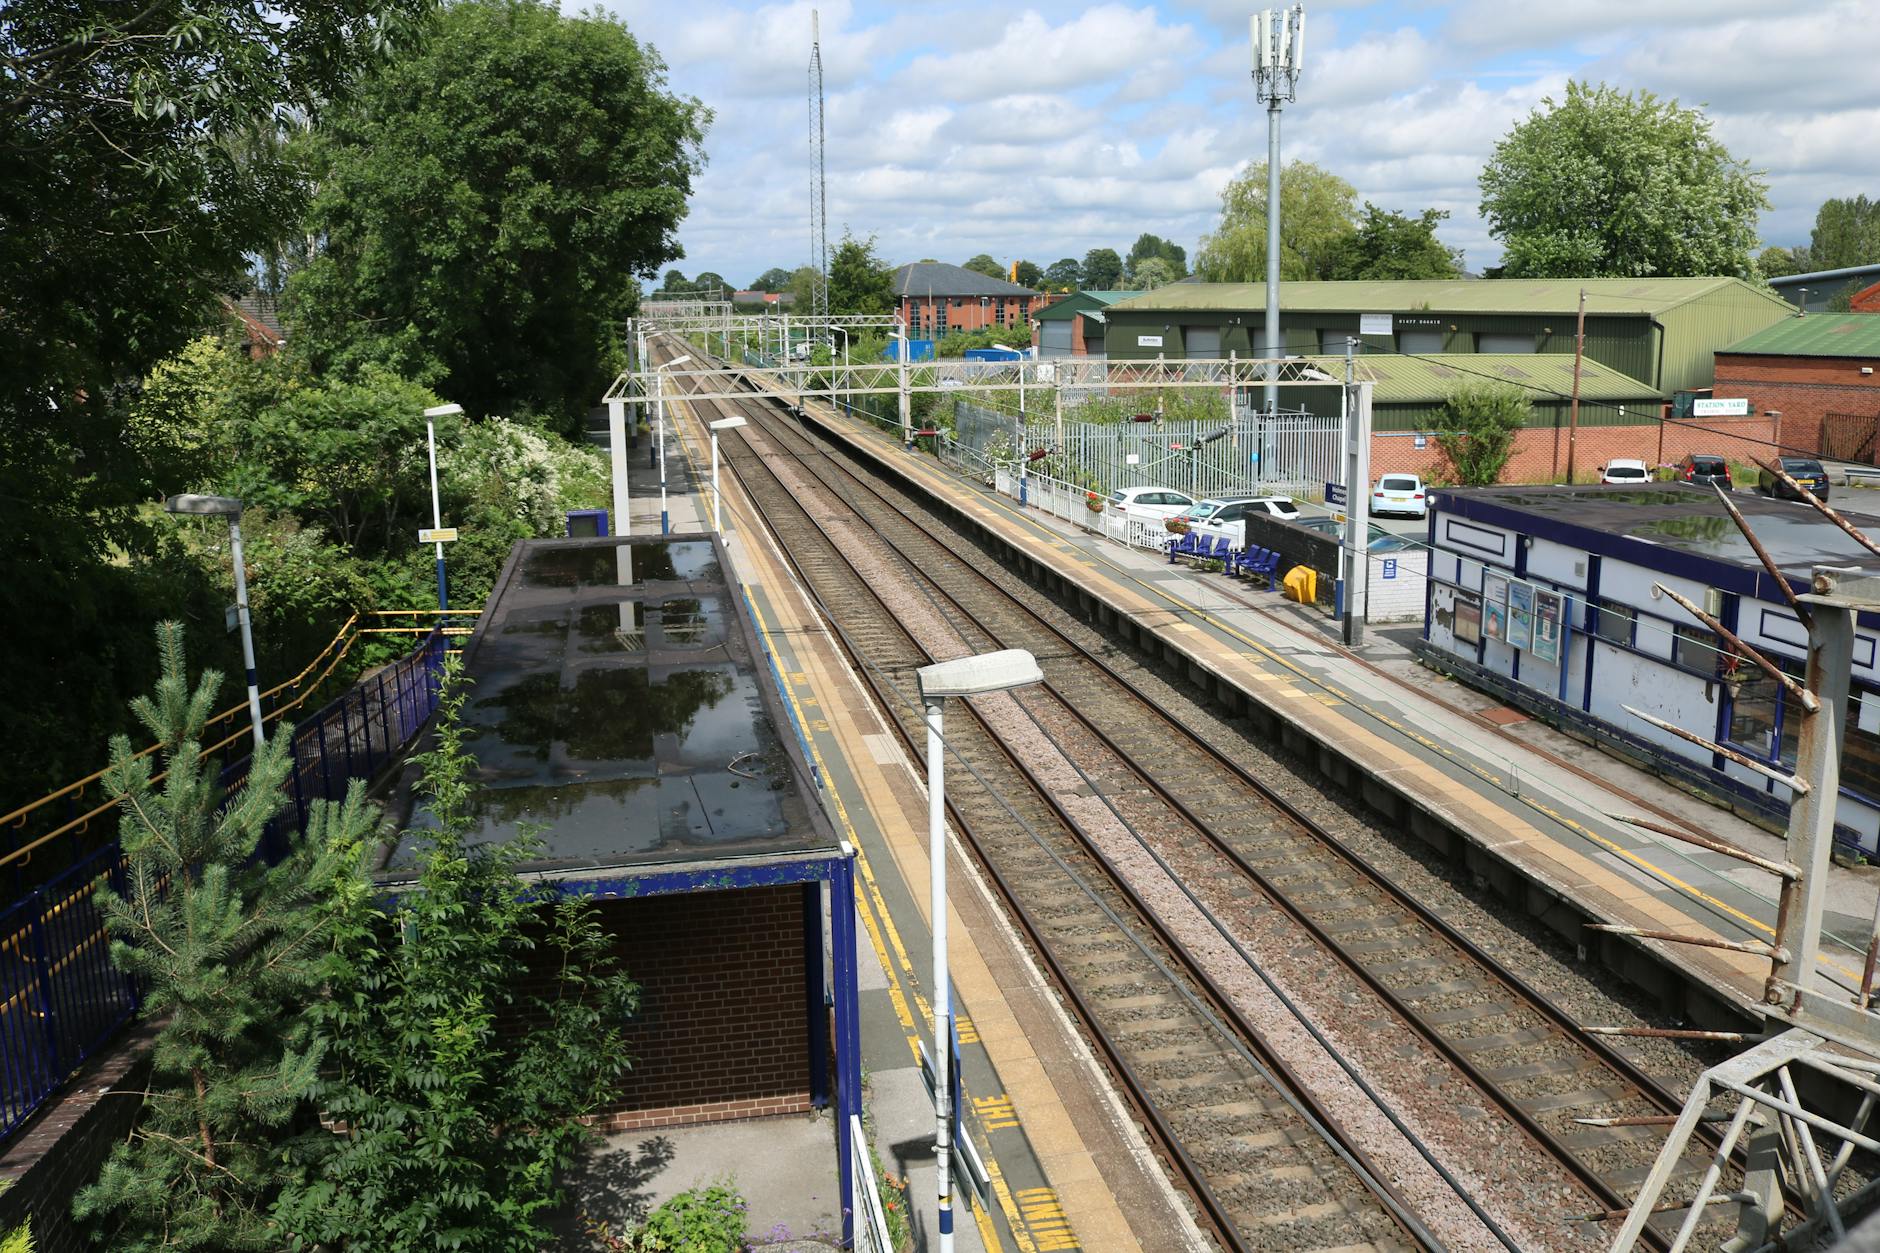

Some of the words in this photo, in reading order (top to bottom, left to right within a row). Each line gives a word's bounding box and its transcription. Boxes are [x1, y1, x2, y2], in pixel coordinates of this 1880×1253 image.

[1697, 401, 1724, 409] STATION
[1728, 400, 1746, 408] YARD
[973, 1093, 1021, 1134] THE
[1016, 1186, 1082, 1252] MIND
